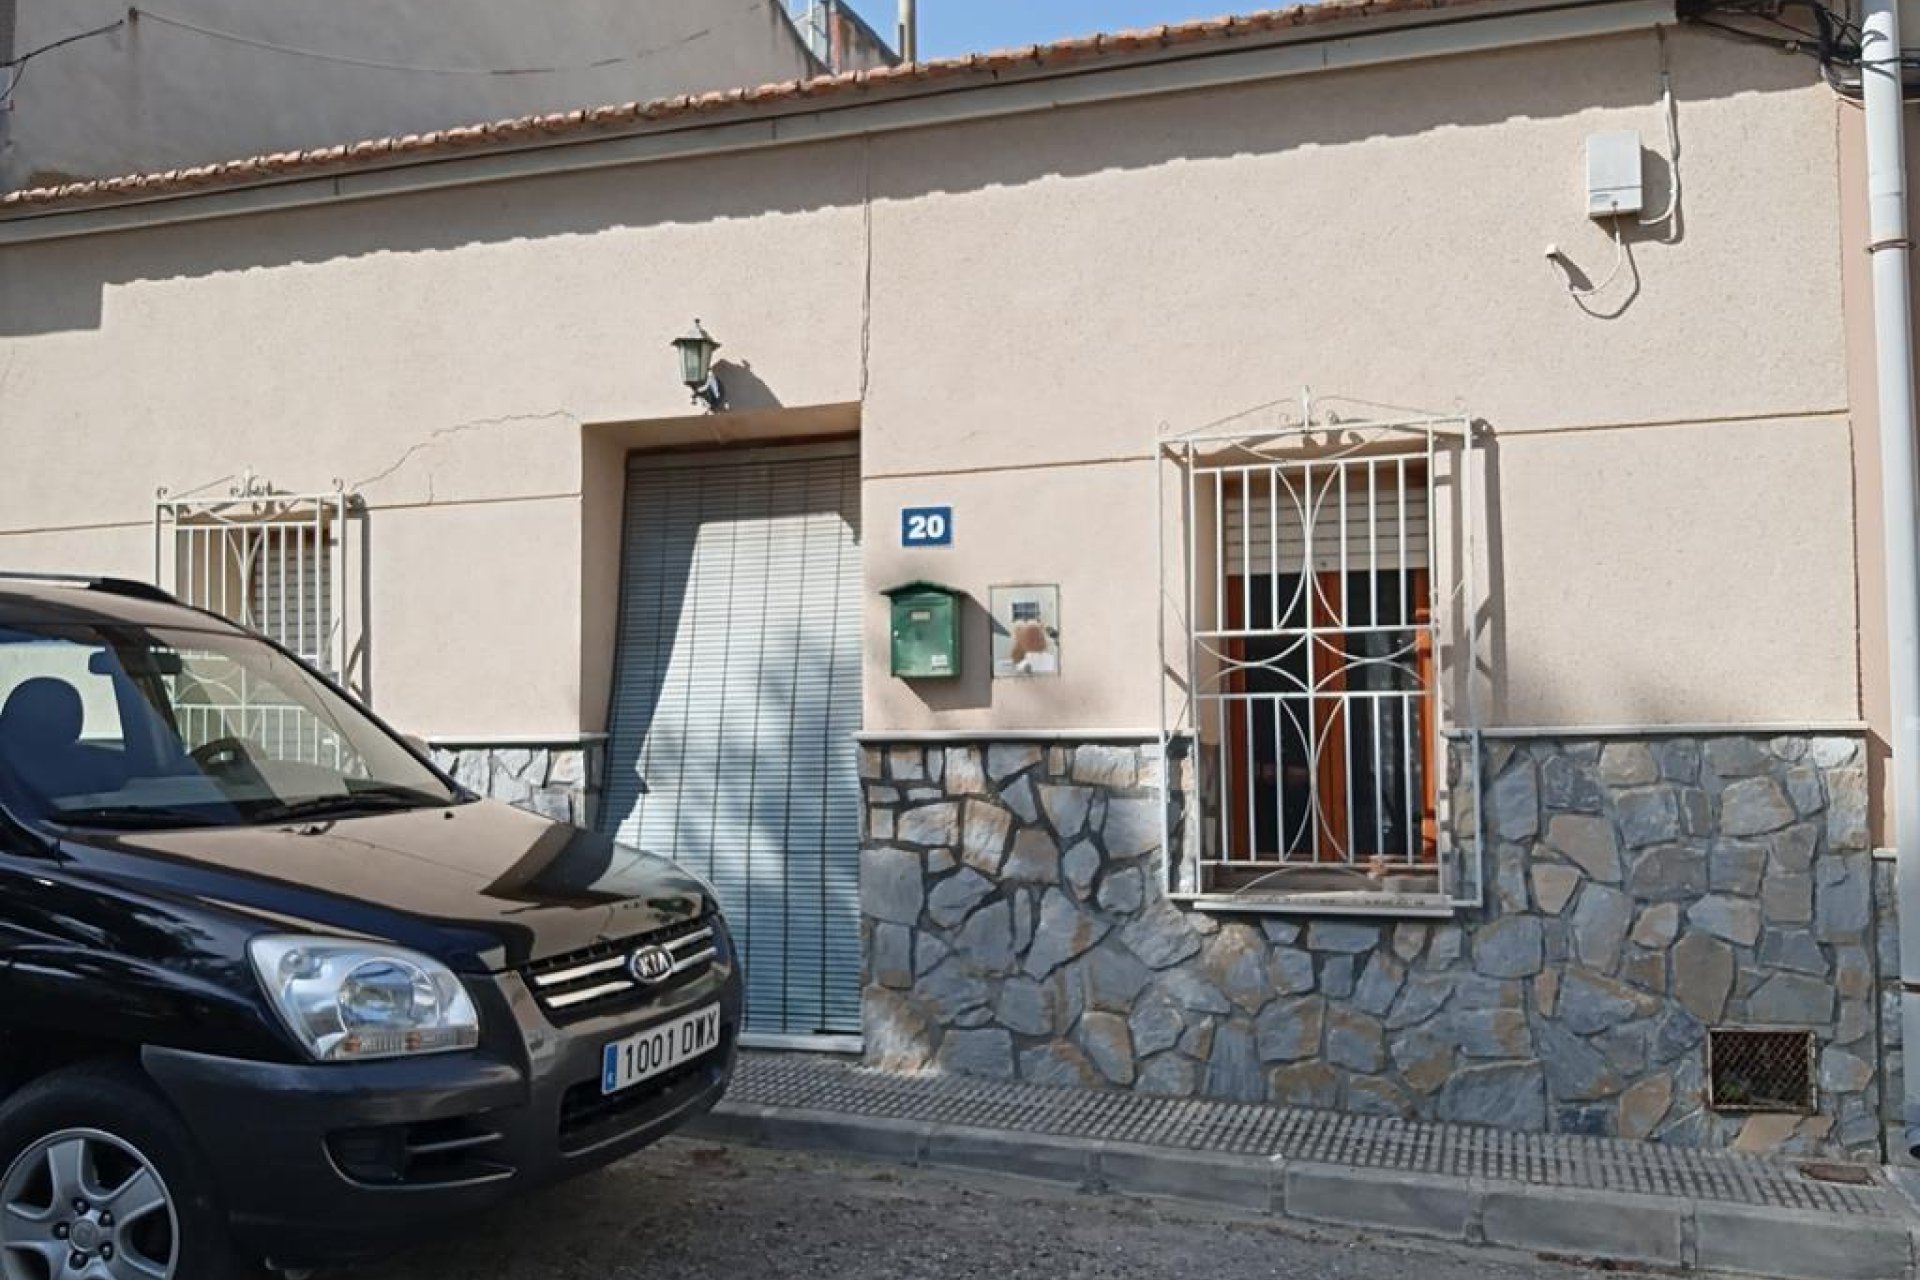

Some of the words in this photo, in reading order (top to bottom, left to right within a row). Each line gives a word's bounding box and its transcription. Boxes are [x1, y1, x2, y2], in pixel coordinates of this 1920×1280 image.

[908, 514, 946, 540] 20
[637, 951, 671, 978] KIA
[626, 1029, 674, 1079] 1001
